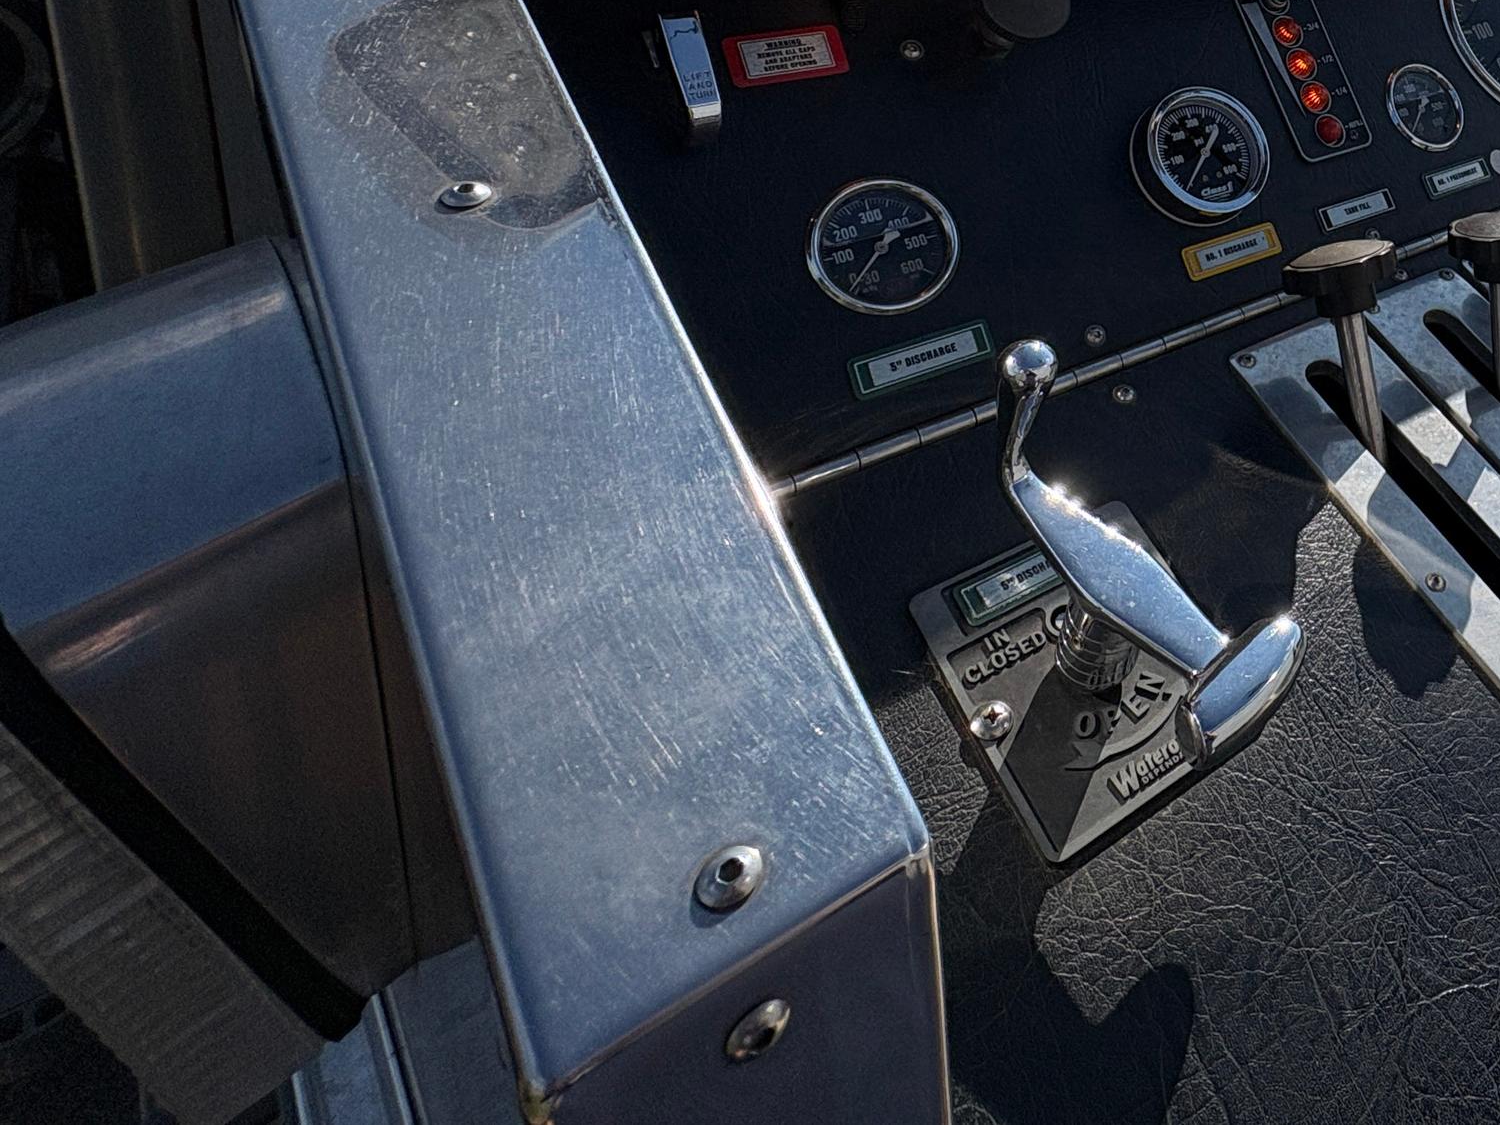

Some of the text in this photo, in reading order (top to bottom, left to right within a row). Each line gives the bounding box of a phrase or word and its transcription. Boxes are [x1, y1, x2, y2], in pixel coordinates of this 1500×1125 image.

[1306, 22, 1320, 31] 3/4
[1471, 21, 1494, 40] 100
[1321, 54, 1334, 64] 1/2
[683, 71, 711, 83] LIFT
[688, 80, 713, 91] AND
[688, 88, 716, 100] TURN
[1335, 88, 1348, 97] 1/4
[1170, 154, 1185, 165] 100
[858, 208, 883, 224] 300
[833, 225, 858, 242] 200
[904, 233, 928, 250] 500
[832, 248, 855, 265] 100
[1205, 251, 1217, 262] NO.
[1223, 239, 1259, 256] DISCHARGE
[900, 258, 924, 274] 600
[889, 342, 958, 372] 5" DISCHARGE
[1017, 560, 1051, 584] DISCH
[984, 628, 1011, 652] IN
[964, 631, 1047, 684] CLOSED
[1073, 669, 1166, 739] OPEN
[1109, 738, 1181, 799] Watero
